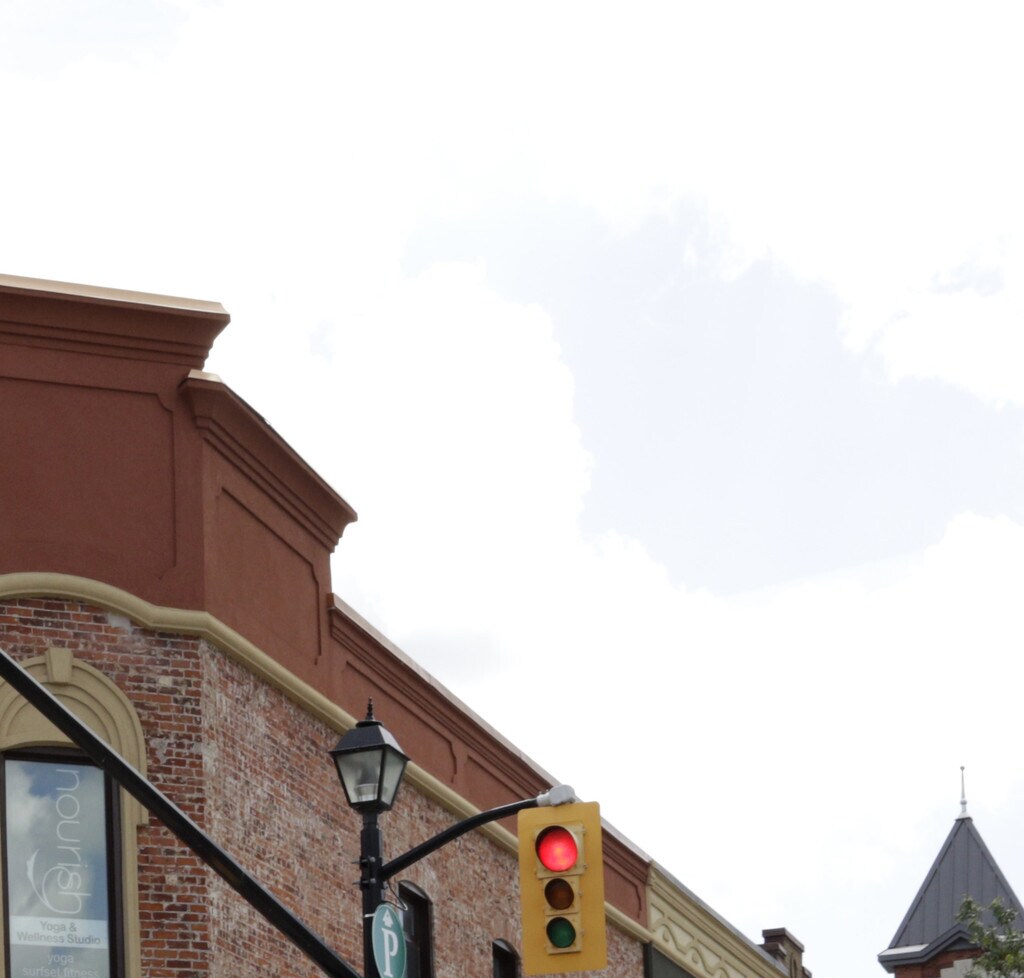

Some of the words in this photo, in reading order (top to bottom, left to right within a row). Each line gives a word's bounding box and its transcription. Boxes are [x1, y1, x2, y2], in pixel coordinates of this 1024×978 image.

[51, 768, 91, 915] nourish
[39, 920, 66, 933] Yoga
[68, 921, 78, 932] &
[16, 931, 65, 943] Wellness
[66, 933, 101, 945] Studio
[47, 953, 74, 965] yoga
[381, 927, 399, 978] P
[63, 966, 100, 978] fitness
